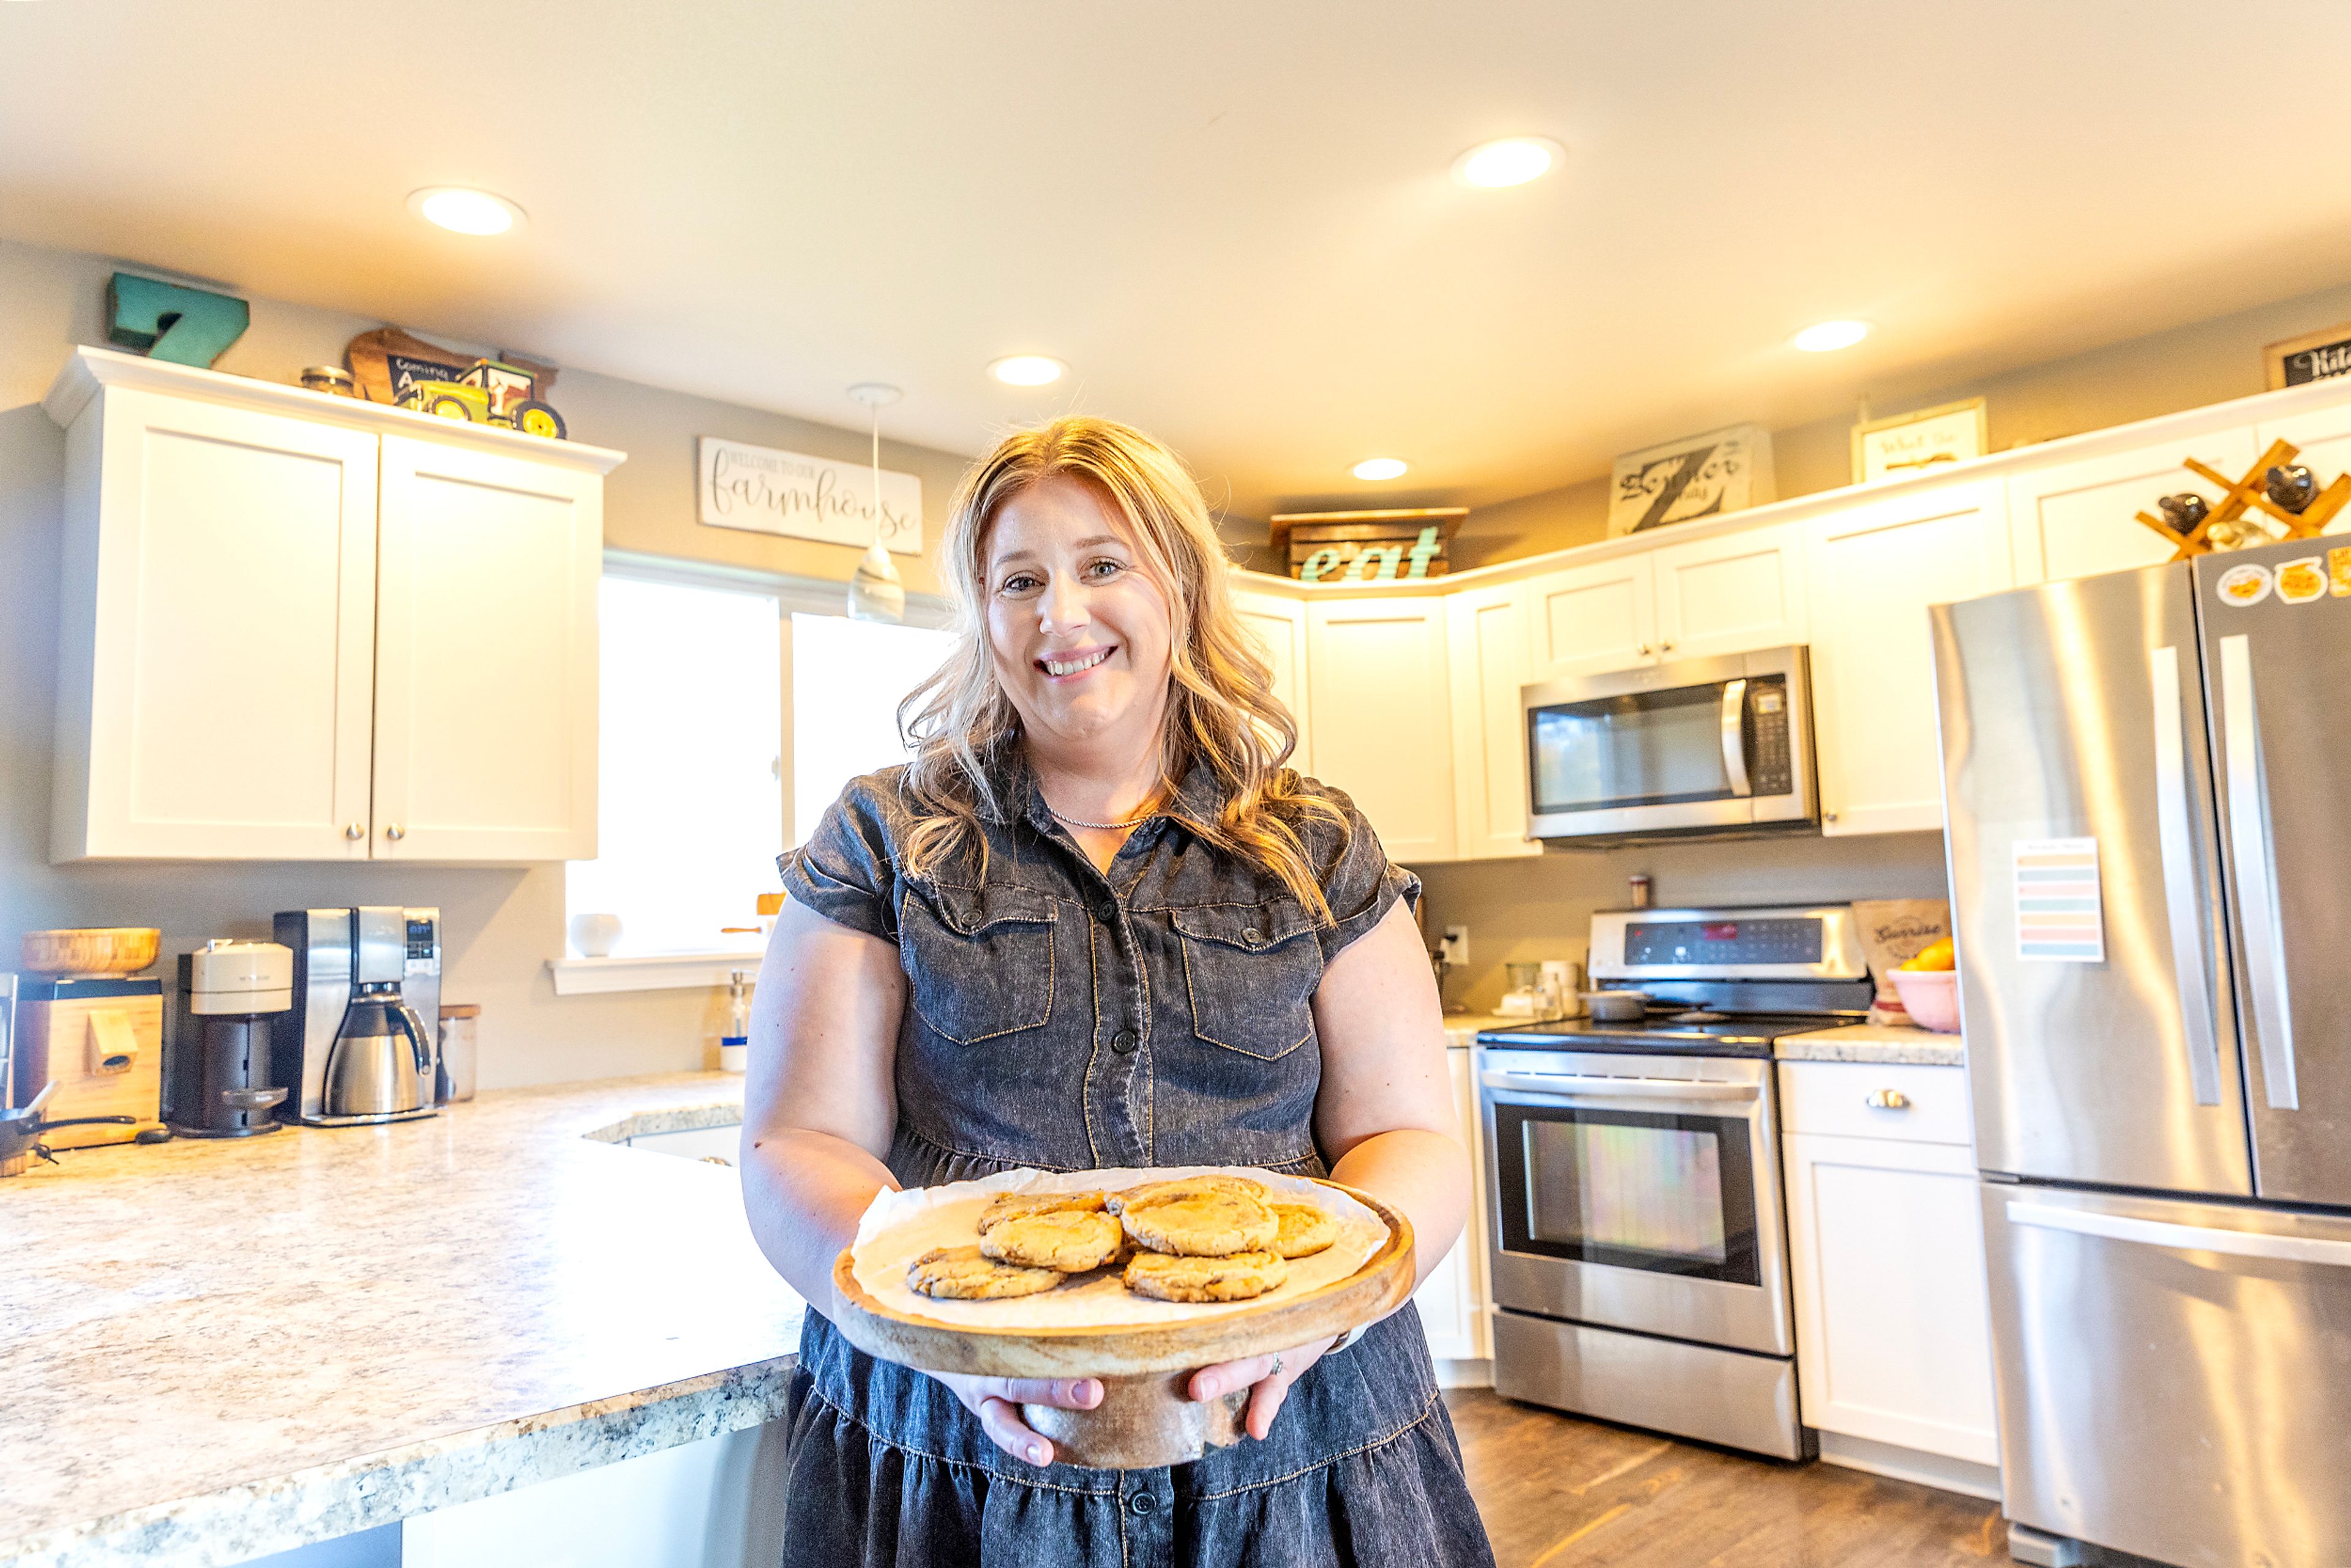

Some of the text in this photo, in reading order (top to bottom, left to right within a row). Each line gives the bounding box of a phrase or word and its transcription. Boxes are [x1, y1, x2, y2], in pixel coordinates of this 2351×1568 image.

[709, 448, 917, 539] farmhouse
[730, 451, 816, 480] WELCOME TO OUR
[1300, 526, 1442, 582] eat
